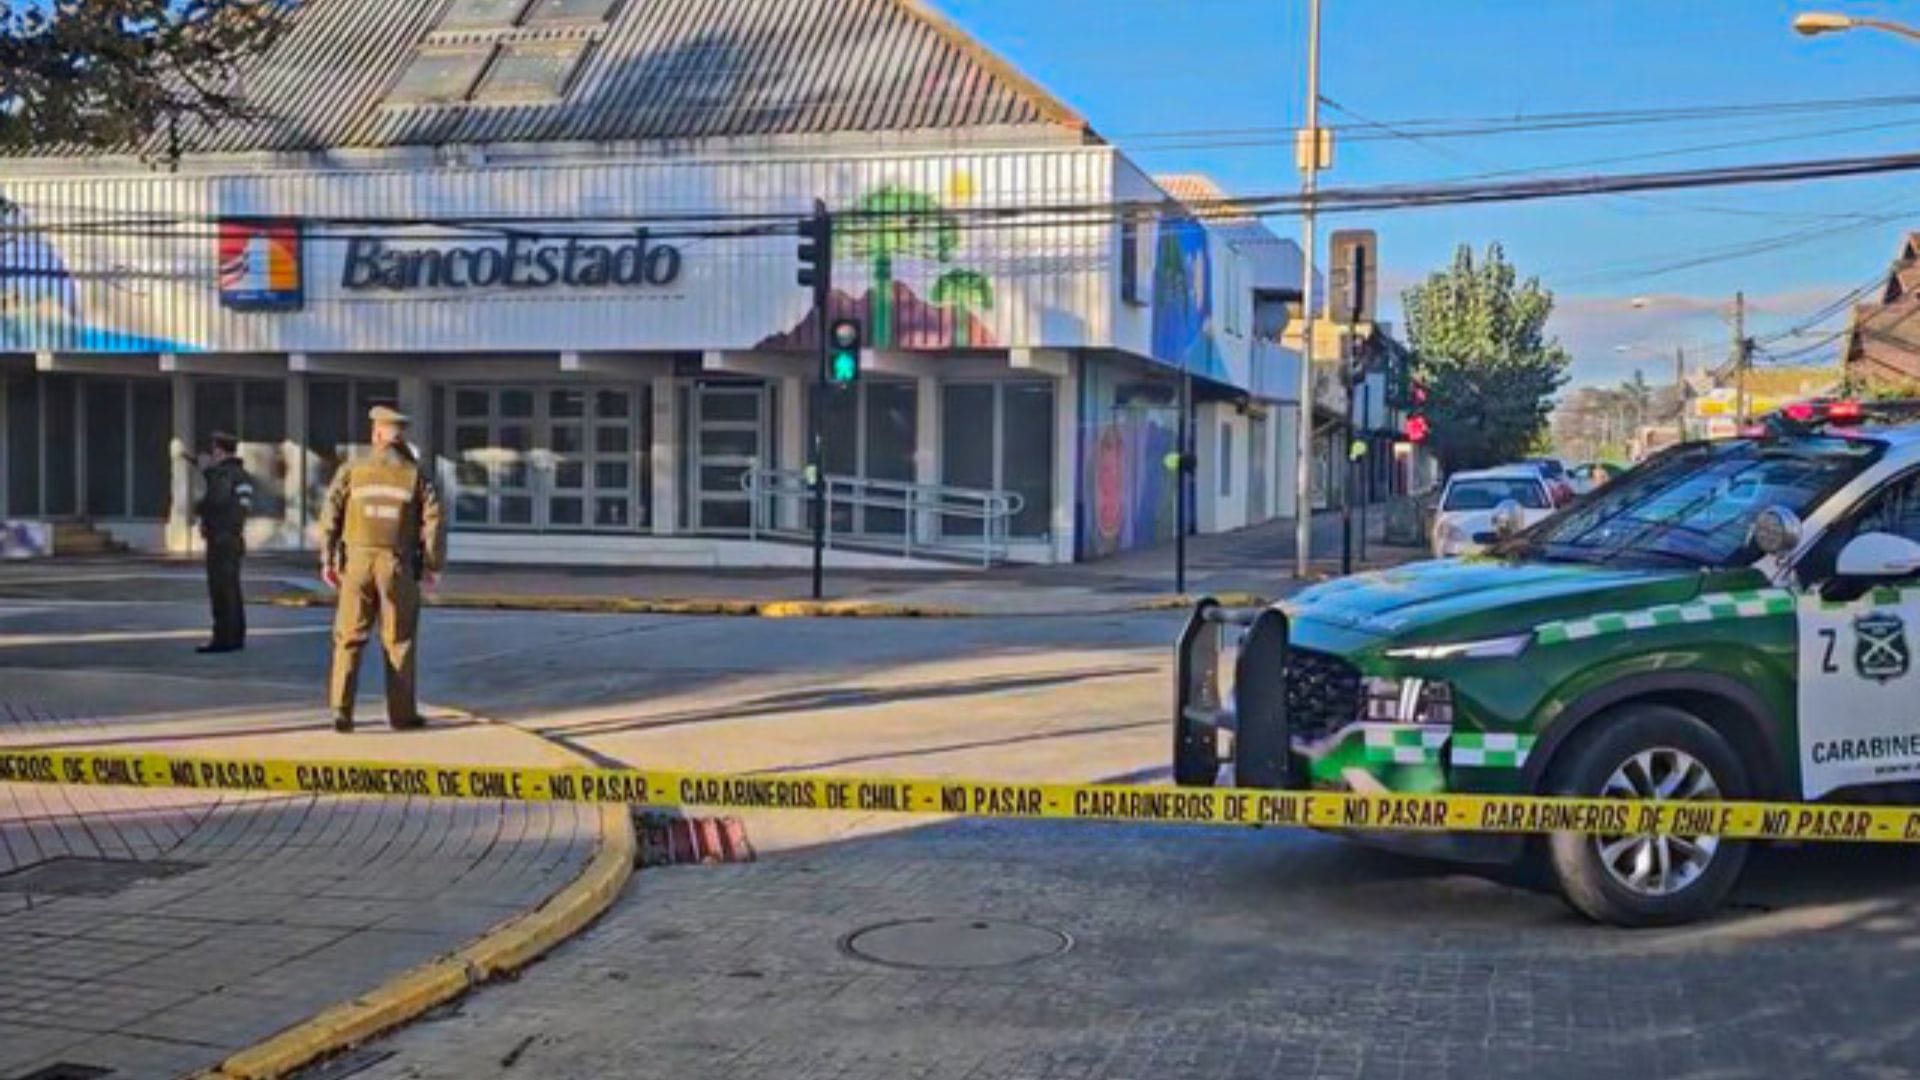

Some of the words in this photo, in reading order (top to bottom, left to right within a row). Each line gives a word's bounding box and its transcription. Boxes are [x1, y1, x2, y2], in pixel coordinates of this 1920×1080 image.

[341, 229, 681, 289] BancoEstado
[1812, 733, 1920, 764] CARABINE
[62, 757, 85, 784] DE
[92, 758, 149, 787] CHILE
[169, 759, 198, 787] NO
[202, 761, 267, 789] PASAR
[296, 764, 430, 794] CARABINEROS
[437, 770, 463, 797] DE
[470, 771, 523, 798] CHILE
[549, 774, 576, 800] NO
[581, 776, 649, 802] PASAR
[680, 778, 817, 808] CARABINEROS
[825, 783, 849, 808] DE
[858, 783, 912, 811] CHILE
[941, 786, 966, 813] NO
[974, 787, 1042, 815] PASAR
[1073, 790, 1213, 820] CARABINEROS
[1223, 796, 1248, 821] DE
[1257, 796, 1313, 824] CHILE
[1344, 798, 1369, 826] NO
[1376, 799, 1448, 828] PASAR
[1481, 801, 1629, 832] CARABINEROS
[1638, 804, 1663, 832] DE
[1670, 806, 1733, 836] CHILE
[1760, 808, 1792, 836] NO
[1796, 810, 1872, 839] PASAR
